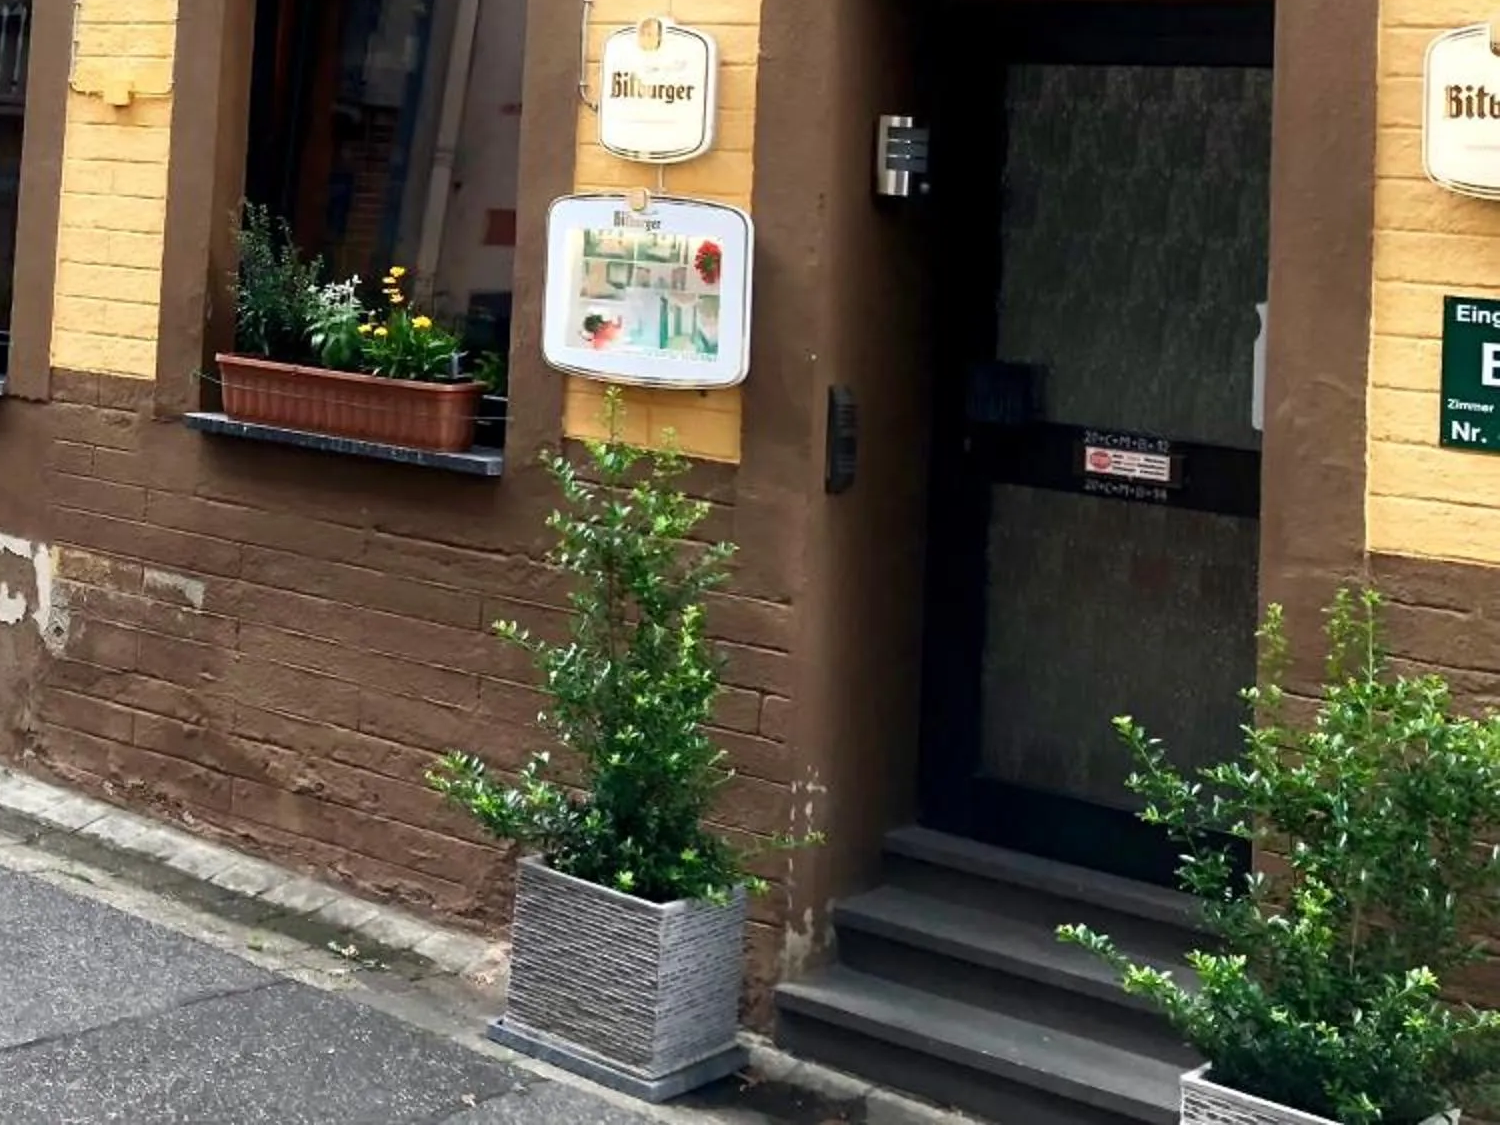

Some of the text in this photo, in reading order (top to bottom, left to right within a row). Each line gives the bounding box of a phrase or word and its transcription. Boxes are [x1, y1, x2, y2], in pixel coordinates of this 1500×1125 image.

[608, 71, 695, 104] Bitburger
[613, 210, 661, 232] Biger
[1447, 398, 1495, 414] Zimmer
[1451, 420, 1488, 444] Nr.
